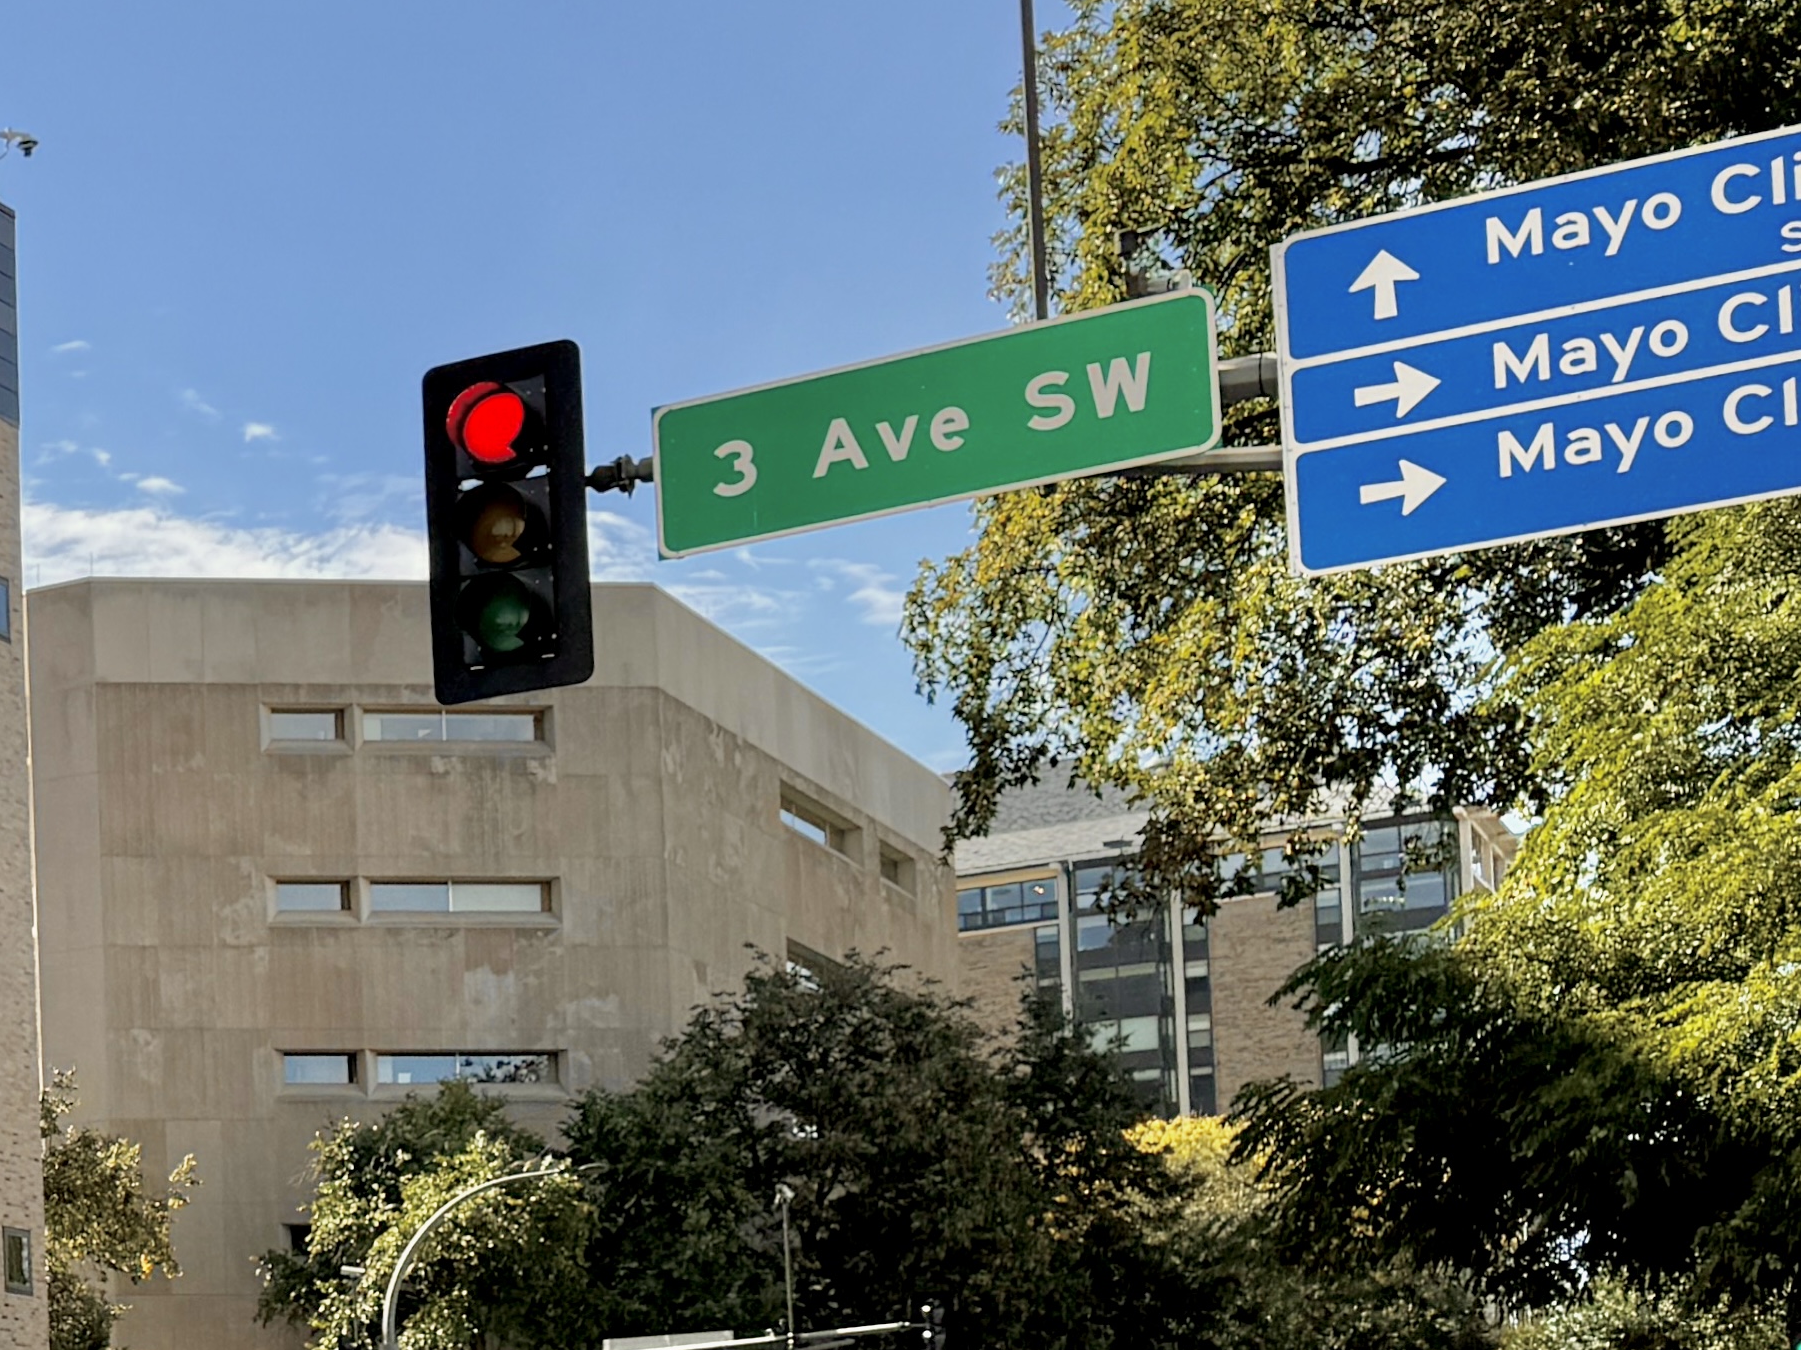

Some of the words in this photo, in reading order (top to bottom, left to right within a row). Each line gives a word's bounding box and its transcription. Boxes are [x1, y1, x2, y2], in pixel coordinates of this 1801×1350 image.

[1485, 192, 1683, 265] Mayo
[1493, 319, 1689, 390] Mayo
[1717, 284, 1801, 343] Cl
[712, 439, 758, 498] 3
[812, 405, 971, 479] Ave
[1024, 350, 1152, 432] SW
[1497, 410, 1694, 479] Mayo
